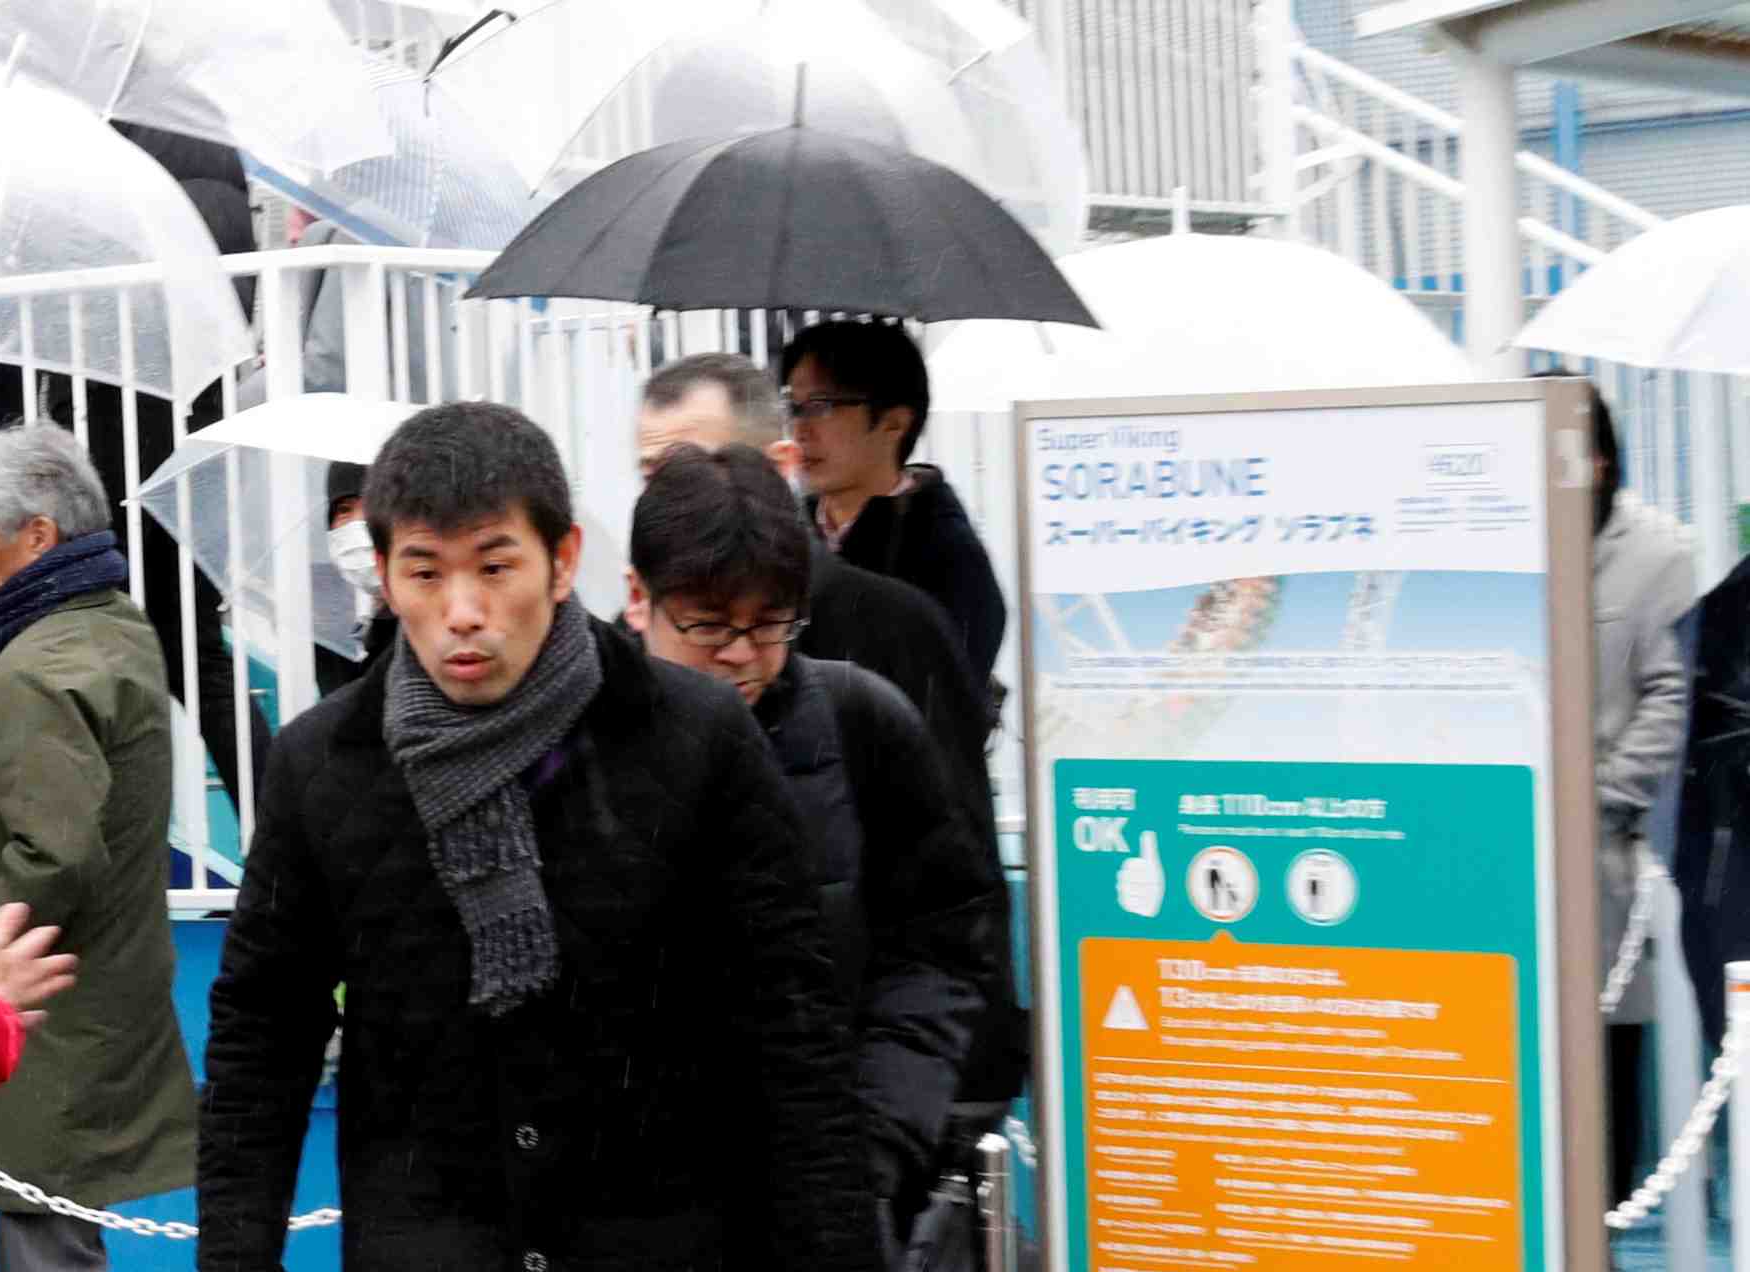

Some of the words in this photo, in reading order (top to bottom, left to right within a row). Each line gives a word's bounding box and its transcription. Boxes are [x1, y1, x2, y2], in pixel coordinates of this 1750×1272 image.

[1037, 427, 1107, 450] Super
[1043, 456, 1269, 500] SORABUNE
[1046, 513, 1262, 545] スーパーバイキング
[1073, 815, 1131, 853] OK
